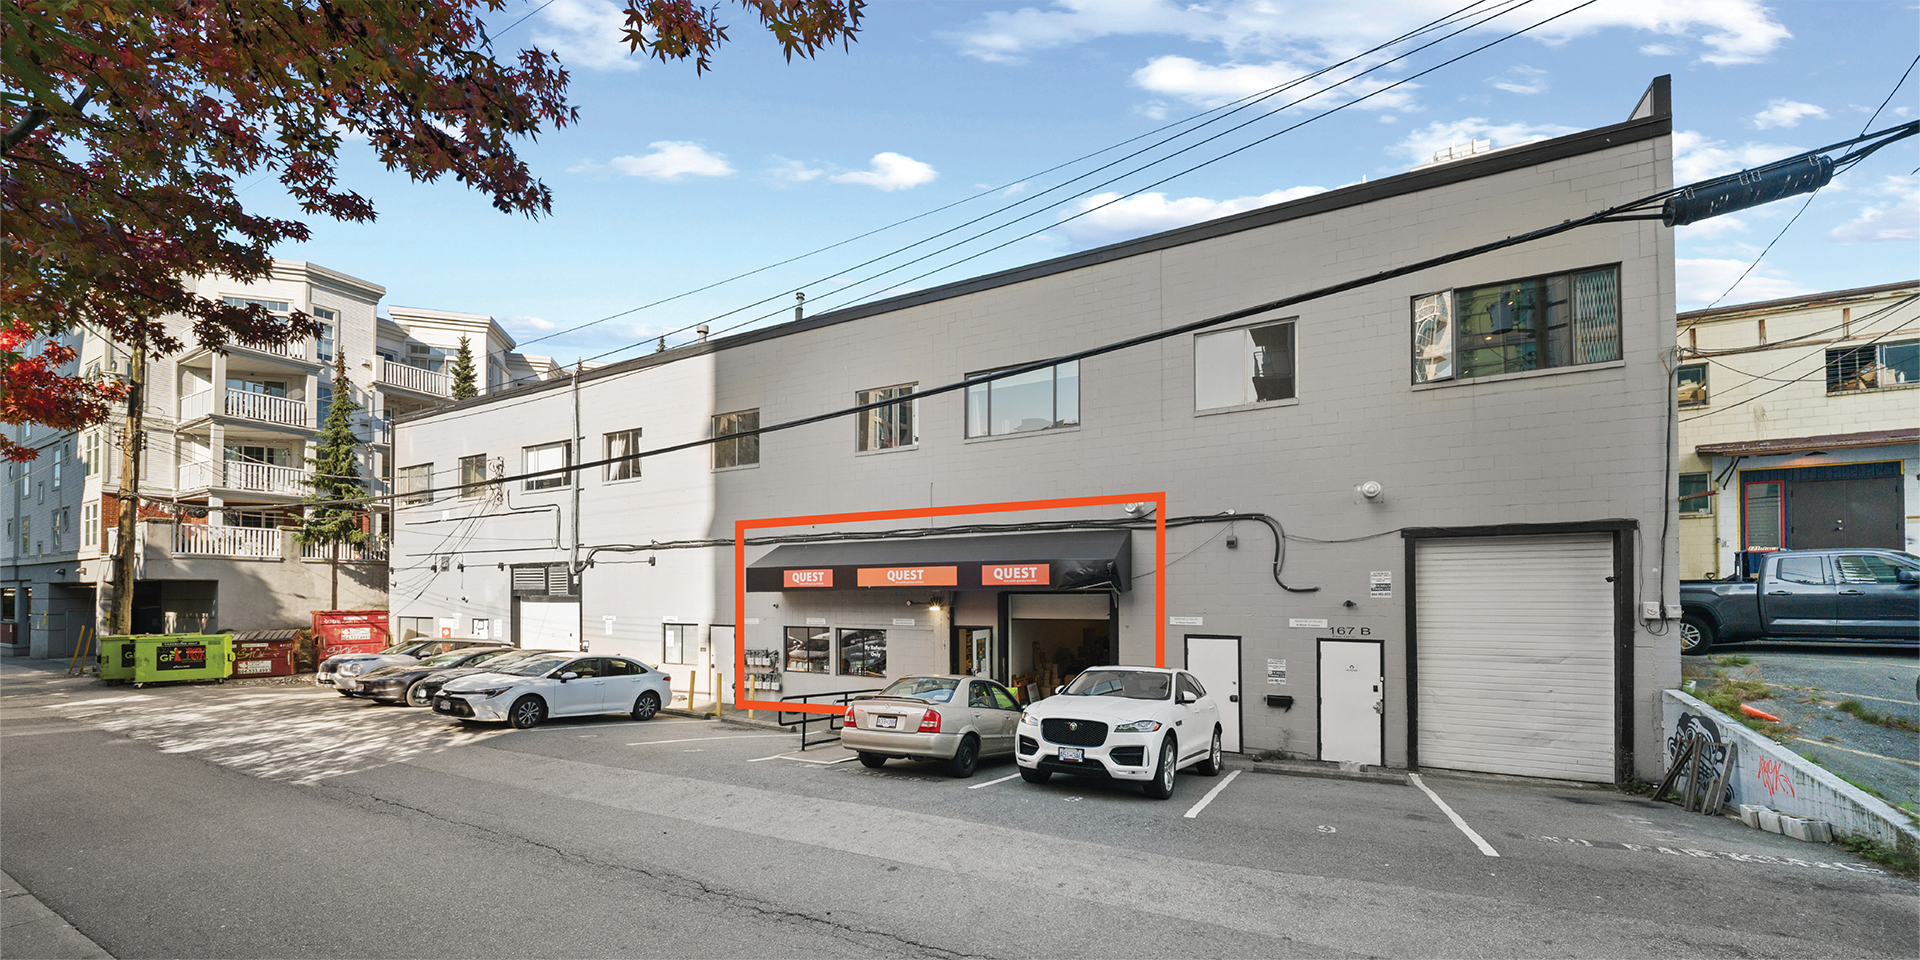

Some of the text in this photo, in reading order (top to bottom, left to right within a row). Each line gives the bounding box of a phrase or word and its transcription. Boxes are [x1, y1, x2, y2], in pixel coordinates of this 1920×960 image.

[792, 572, 824, 583] QUEST
[887, 569, 924, 582] QUEST
[993, 567, 1037, 580] QUEST
[1329, 627, 1371, 635] 167 B
[159, 654, 178, 662] GF
